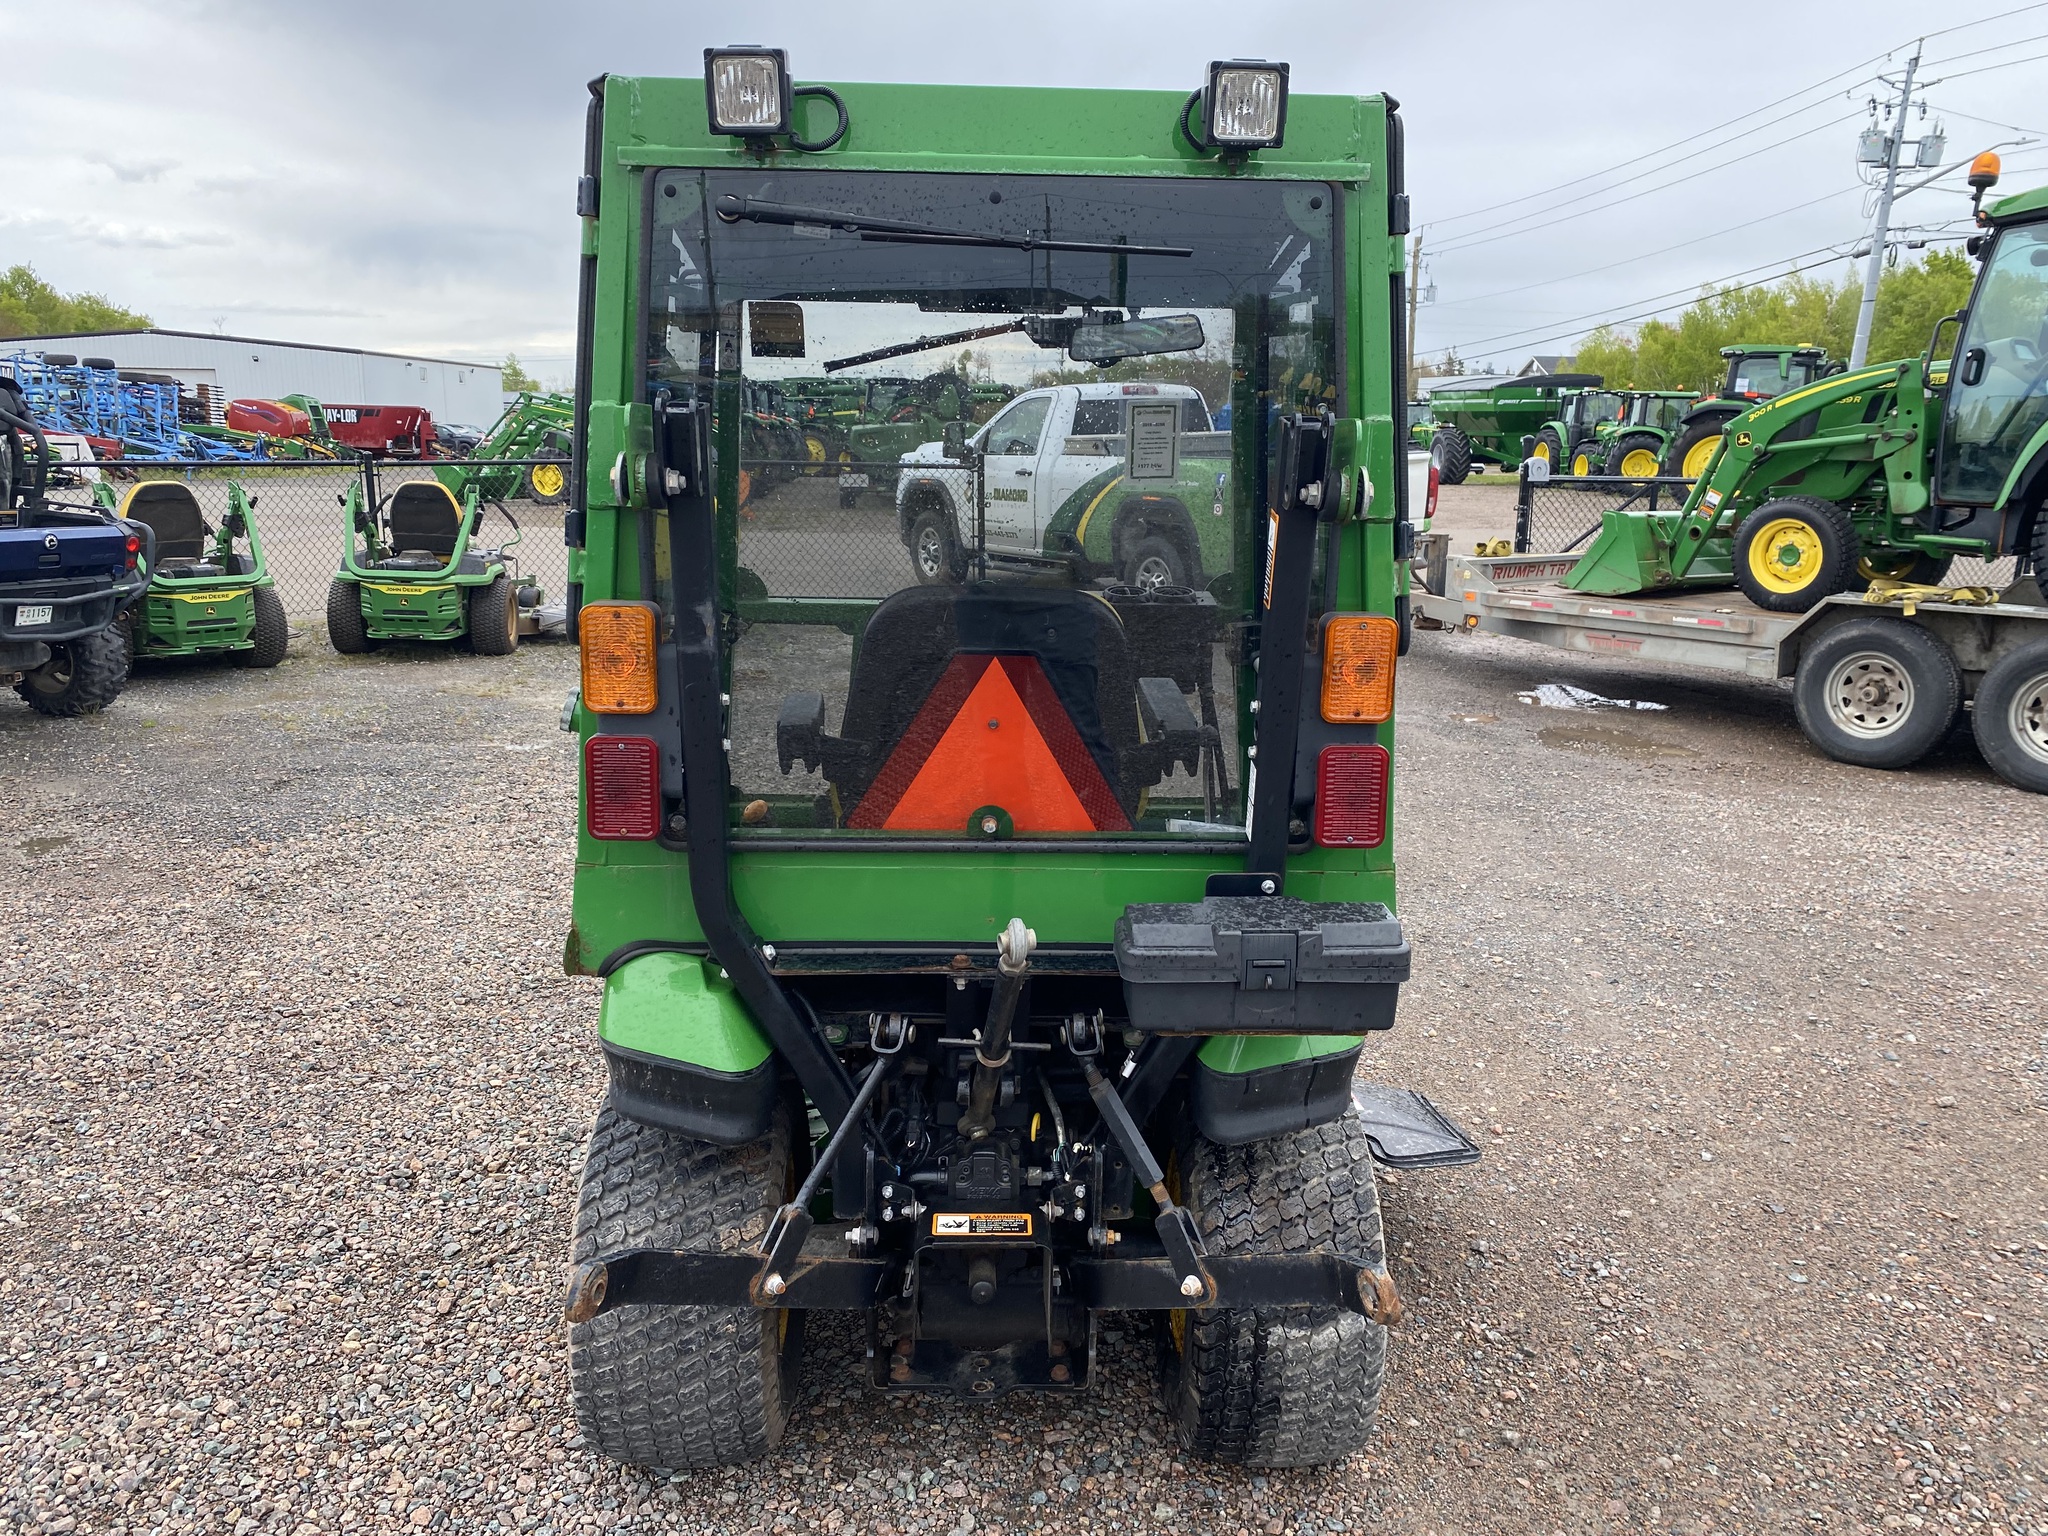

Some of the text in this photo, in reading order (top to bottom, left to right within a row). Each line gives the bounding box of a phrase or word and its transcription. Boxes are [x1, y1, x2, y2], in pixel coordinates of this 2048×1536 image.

[1492, 563, 1574, 580] RIUMPH TRA
[32, 607, 52, 618] 1157
